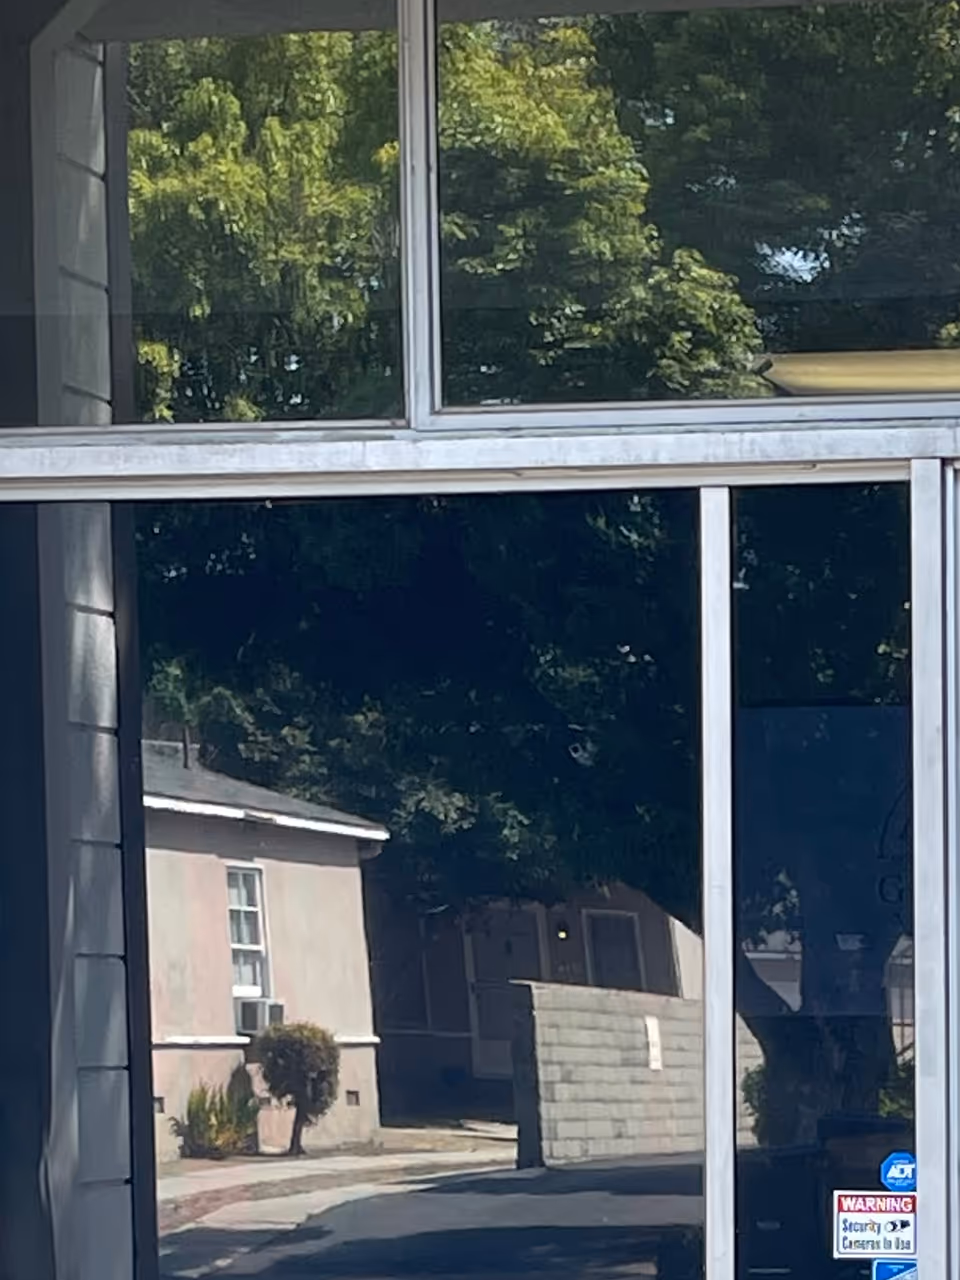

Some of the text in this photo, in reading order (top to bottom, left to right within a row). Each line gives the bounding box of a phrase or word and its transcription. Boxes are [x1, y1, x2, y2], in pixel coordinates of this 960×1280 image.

[886, 1164, 916, 1179] ADT
[841, 1196, 913, 1212] WARNING
[842, 1218, 881, 1236] Security
[842, 1236, 881, 1250] Cameras
[895, 1236, 911, 1250] Use
